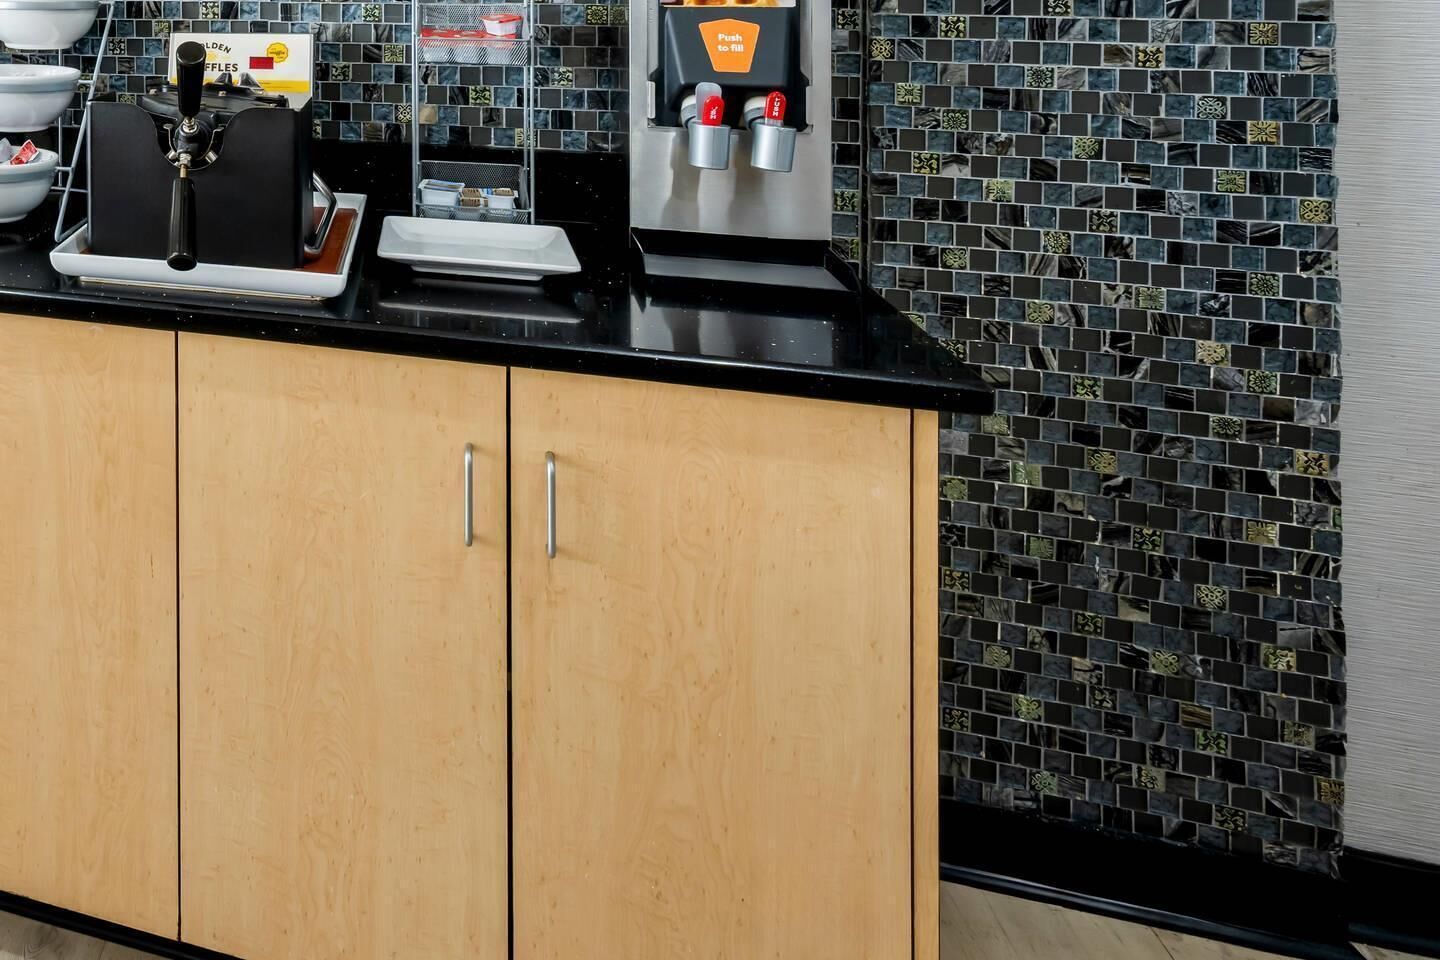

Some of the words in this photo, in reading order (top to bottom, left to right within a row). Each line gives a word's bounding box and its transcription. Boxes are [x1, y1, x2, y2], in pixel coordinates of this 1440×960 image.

[718, 33, 742, 42] Push
[718, 44, 729, 52] to
[730, 44, 743, 52] fill
